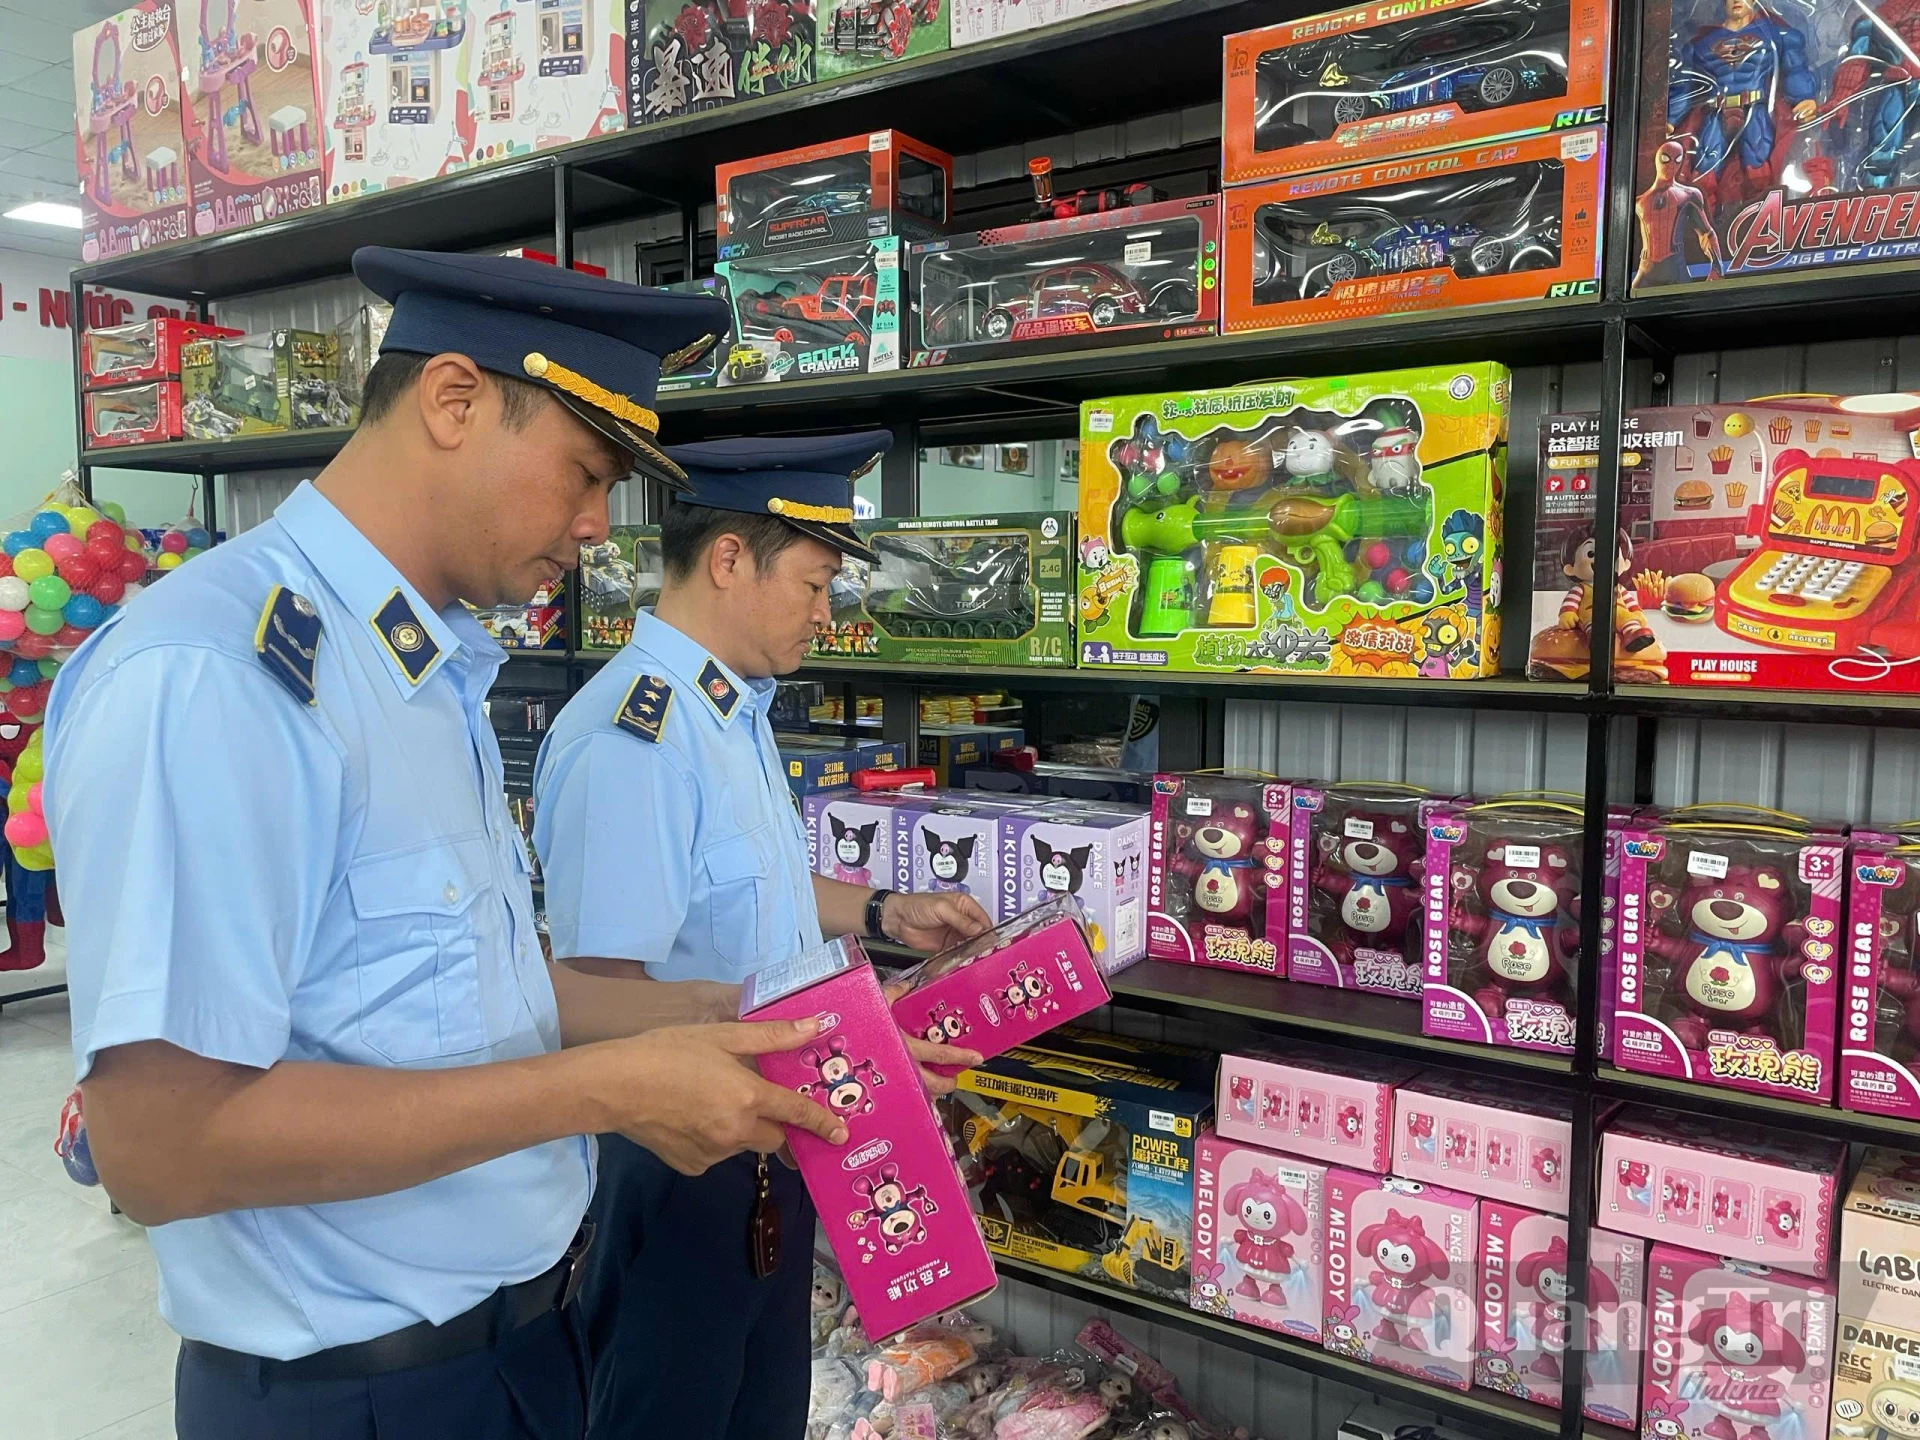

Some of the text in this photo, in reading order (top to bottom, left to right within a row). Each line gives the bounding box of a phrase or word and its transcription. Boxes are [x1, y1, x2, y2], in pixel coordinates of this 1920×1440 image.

[1291, 13, 1365, 40] REMOTE
[1556, 107, 1602, 128] R/C
[1288, 146, 1519, 197] REMOTE CONTROL CAR
[1784, 242, 1920, 266] AGE OF ULTR
[1550, 281, 1596, 298] R/C
[800, 357, 860, 374] CRAWLER
[1548, 430, 1684, 453] 益智超收银机
[1551, 418, 1639, 434] PLAY HSE
[1560, 458, 1580, 466] FUN
[1041, 563, 1061, 574] 2.4G
[1030, 636, 1062, 657] R/C
[1737, 622, 1829, 645] CASH REGISTER
[1691, 659, 1757, 672] PLAY HOUSE
[1269, 792, 1283, 804] 3+
[879, 818, 888, 863] DANCE
[978, 832, 987, 877] DANCE
[897, 830, 909, 894] KUROM
[1093, 841, 1103, 890] DANCE
[1151, 821, 1164, 906] ROSE BEAR
[1808, 856, 1831, 872] 3+
[1292, 838, 1305, 928] ROSE BEAR
[1351, 911, 1375, 923] Rose
[1428, 874, 1444, 977] ROSE BEAR
[1206, 937, 1276, 969] 玫瑰熊
[1620, 893, 1640, 1003] ROSE BEAR
[1502, 958, 1532, 971] Rose
[1701, 983, 1736, 1000] Rose
[1849, 922, 1873, 1042] ROSE BEAR
[1507, 1012, 1576, 1045] 玫瑰
[1709, 1046, 1821, 1093] 玫瑰熊
[1177, 1119, 1189, 1129] 8+
[1132, 1134, 1178, 1157] POWER
[1307, 1170, 1320, 1220] DANCE
[1197, 1167, 1214, 1261] MELODY
[1329, 1206, 1346, 1302] MELODY
[1450, 1214, 1463, 1264] DANCE
[887, 1262, 951, 1301] 产品功能
[890, 1258, 941, 1286] PRODUCT FEATURES
[1619, 1242, 1635, 1298] DANCE
[1859, 1250, 1920, 1282] LAB
[1484, 1233, 1505, 1334] MELODY
[1862, 1278, 1900, 1294] ELECTRIC
[1651, 1287, 1675, 1394] MELODY
[1806, 1300, 1825, 1356] DANCE
[1843, 1324, 1920, 1357] DANCE
[1838, 1351, 1871, 1370] REC
